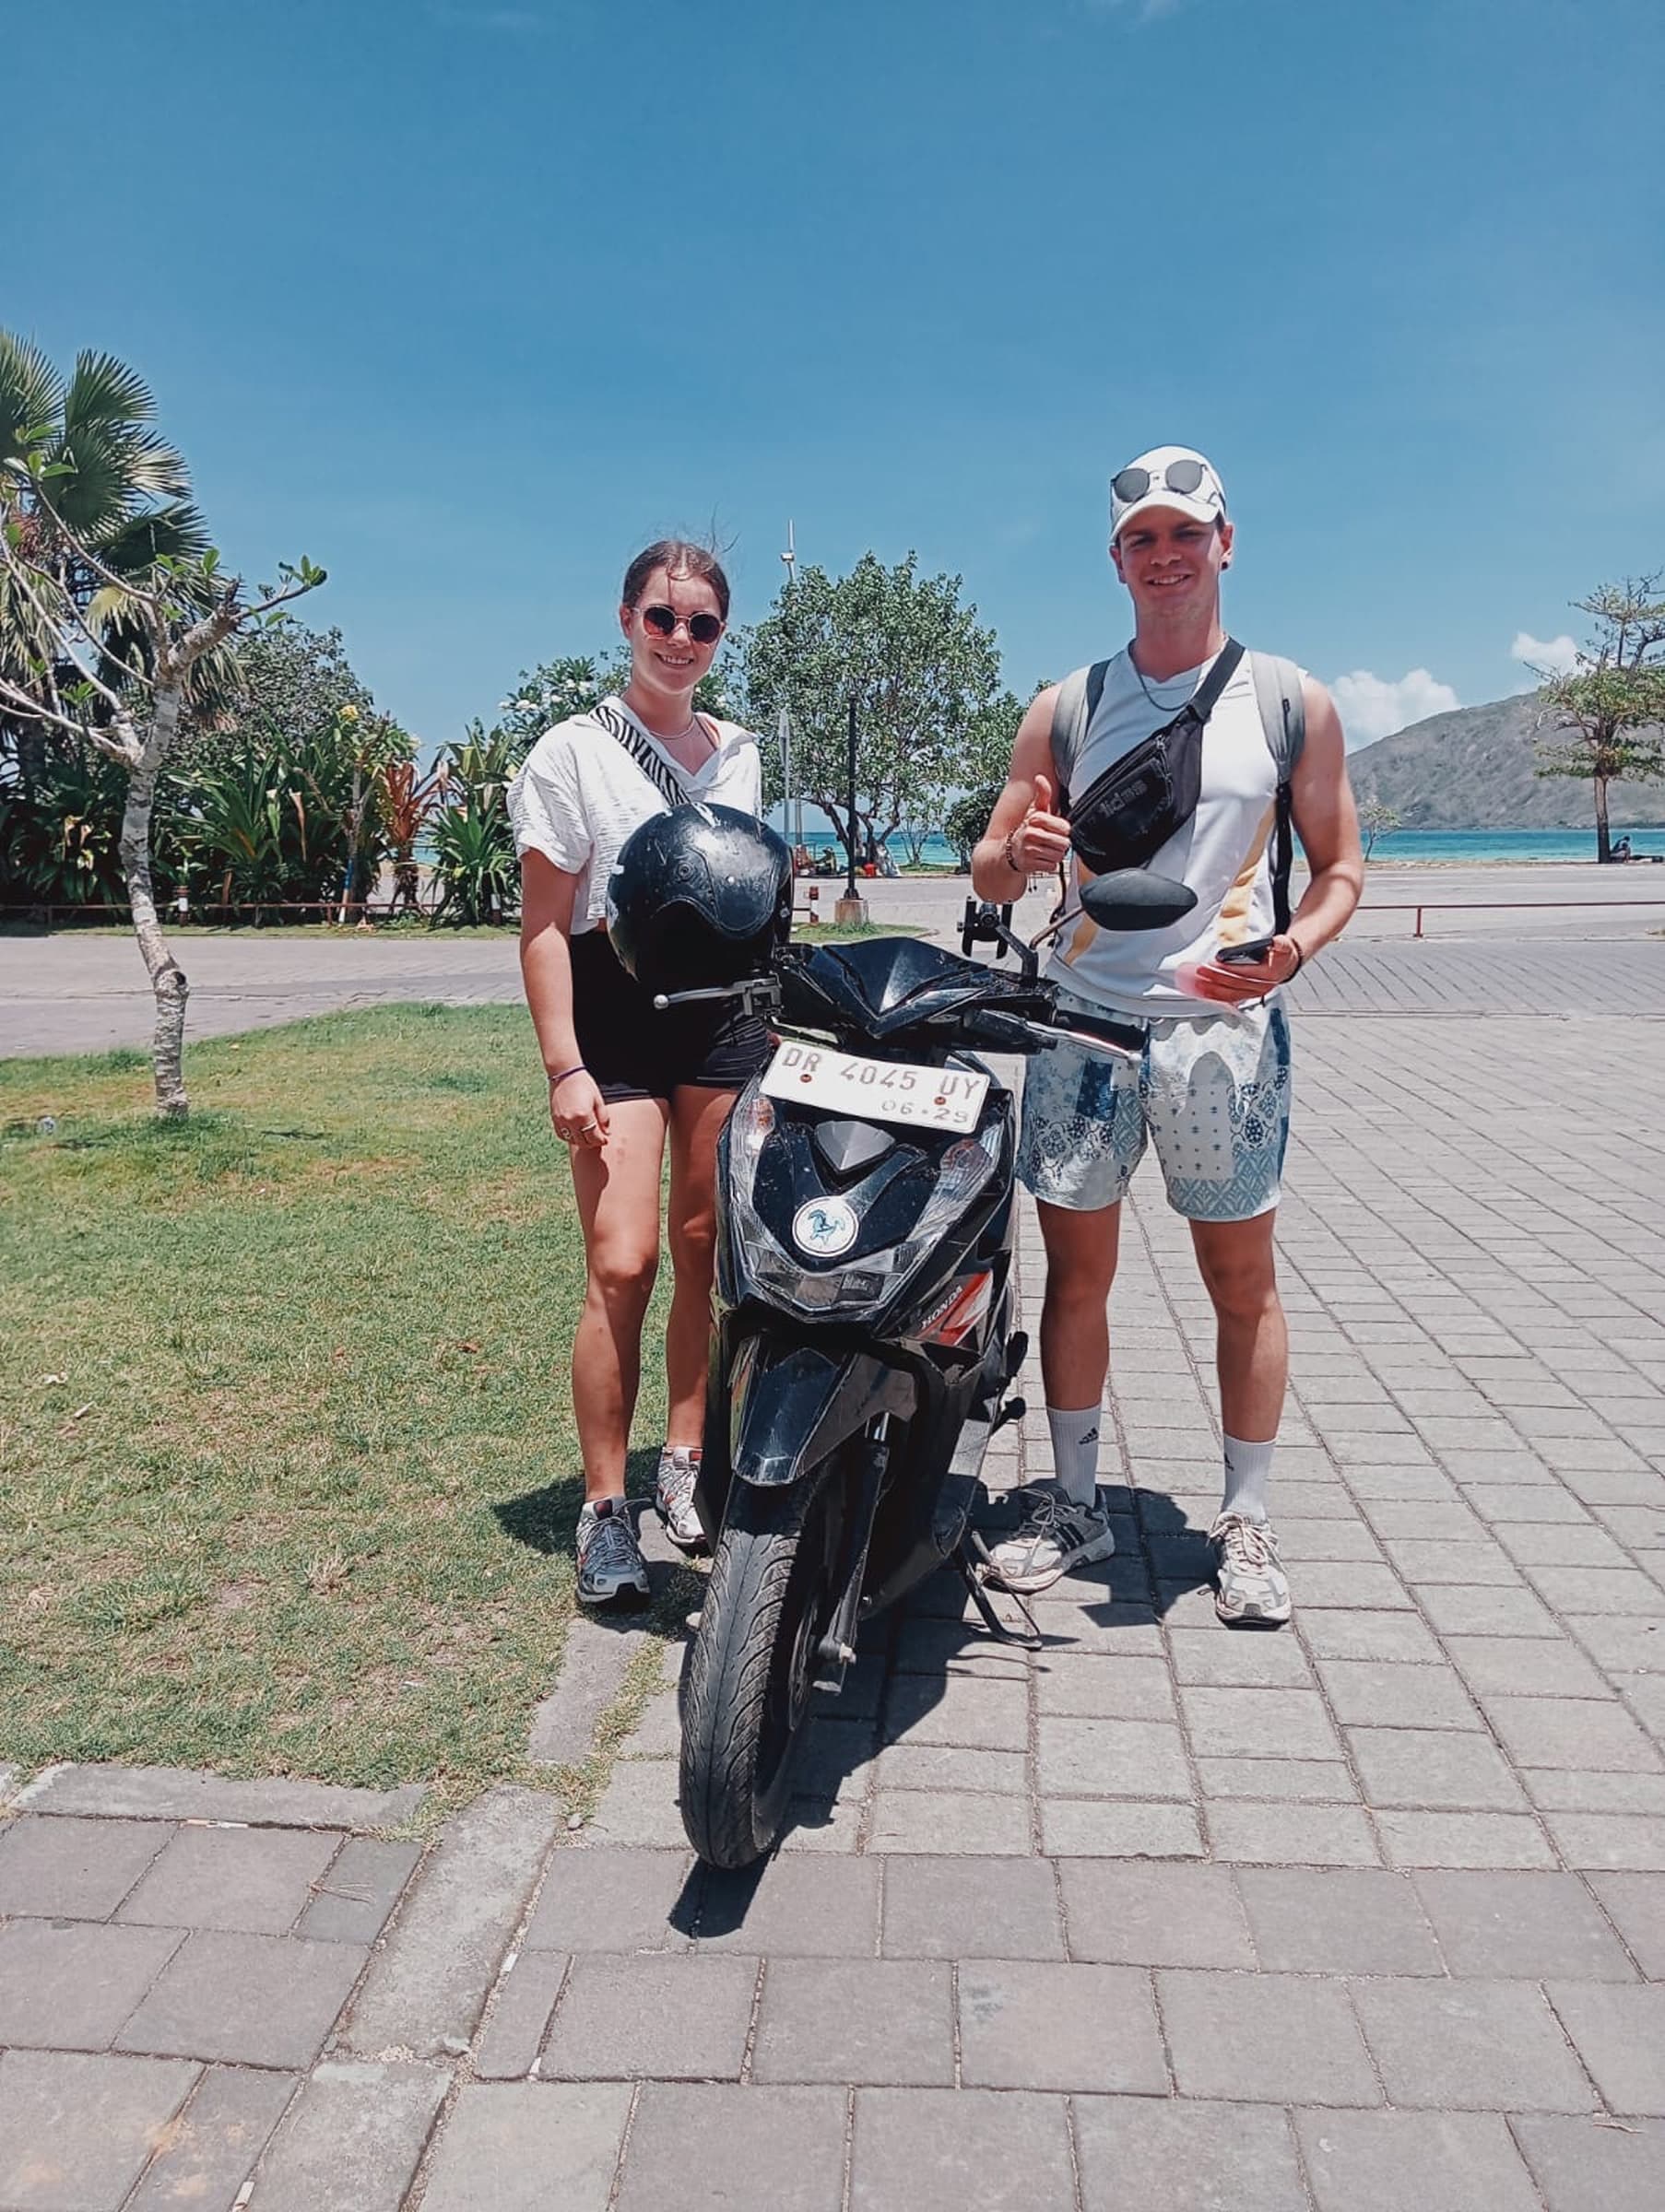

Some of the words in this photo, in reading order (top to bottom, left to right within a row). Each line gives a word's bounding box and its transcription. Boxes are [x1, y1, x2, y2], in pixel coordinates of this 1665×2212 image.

[782, 1047, 822, 1073] DR
[840, 1062, 918, 1090] 4045
[939, 1074, 981, 1100] UY
[922, 1286, 962, 1329] HONDA
